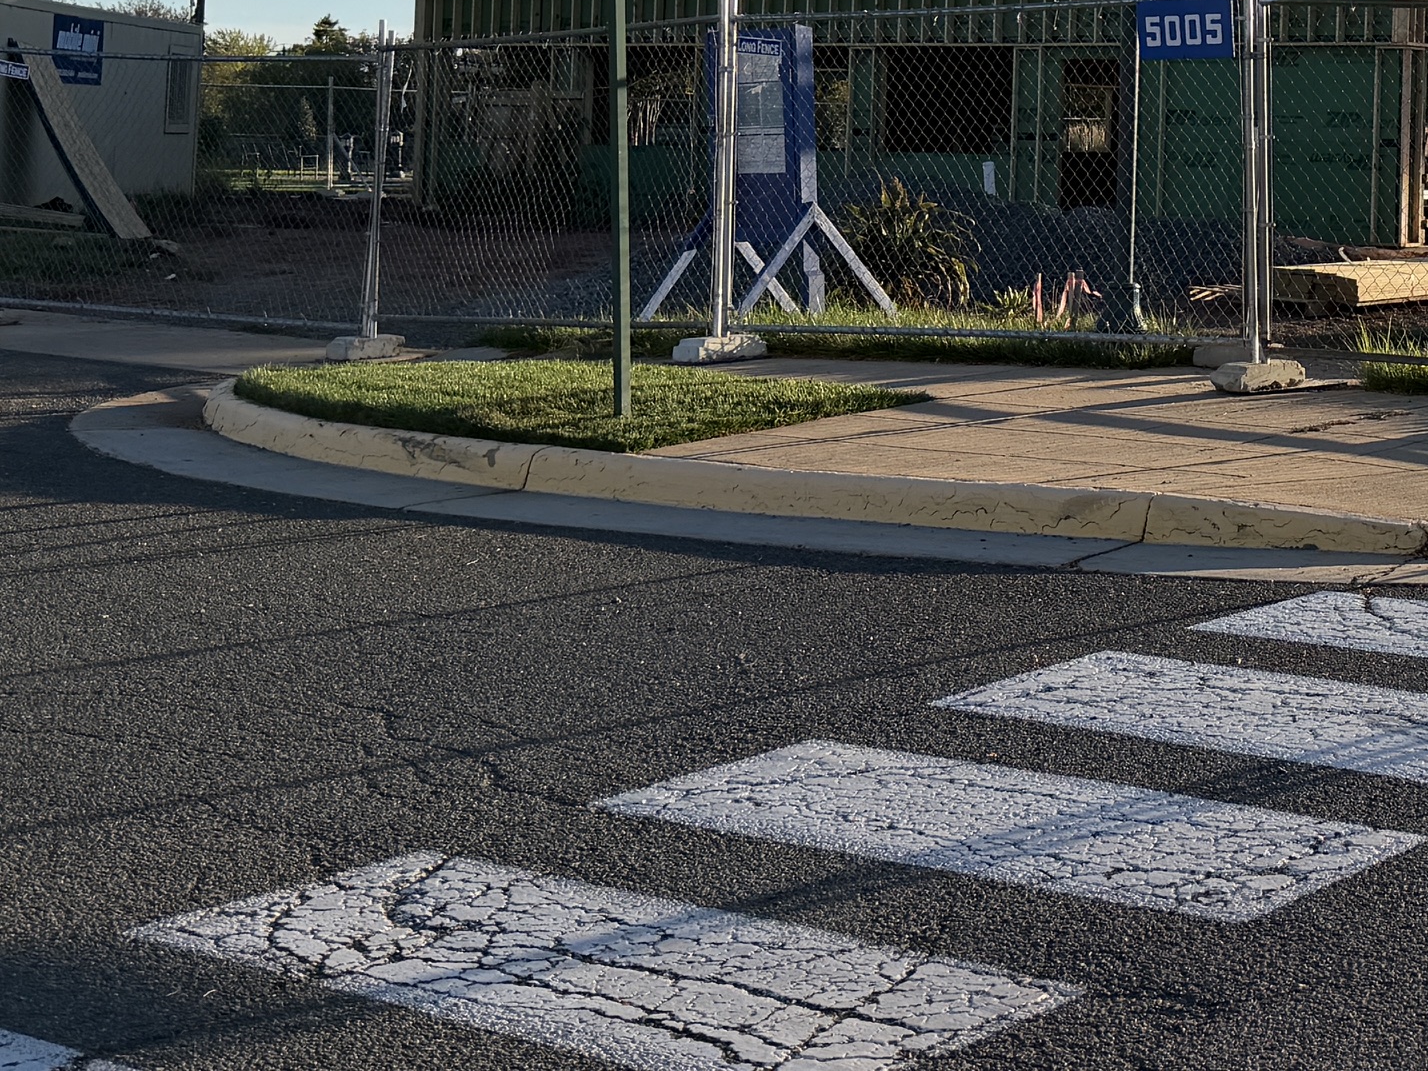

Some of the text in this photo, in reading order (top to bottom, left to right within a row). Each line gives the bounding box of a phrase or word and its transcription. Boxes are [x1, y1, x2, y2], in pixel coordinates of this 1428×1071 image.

[1145, 13, 1223, 47] 5005
[738, 39, 779, 55] LONG FENCE
